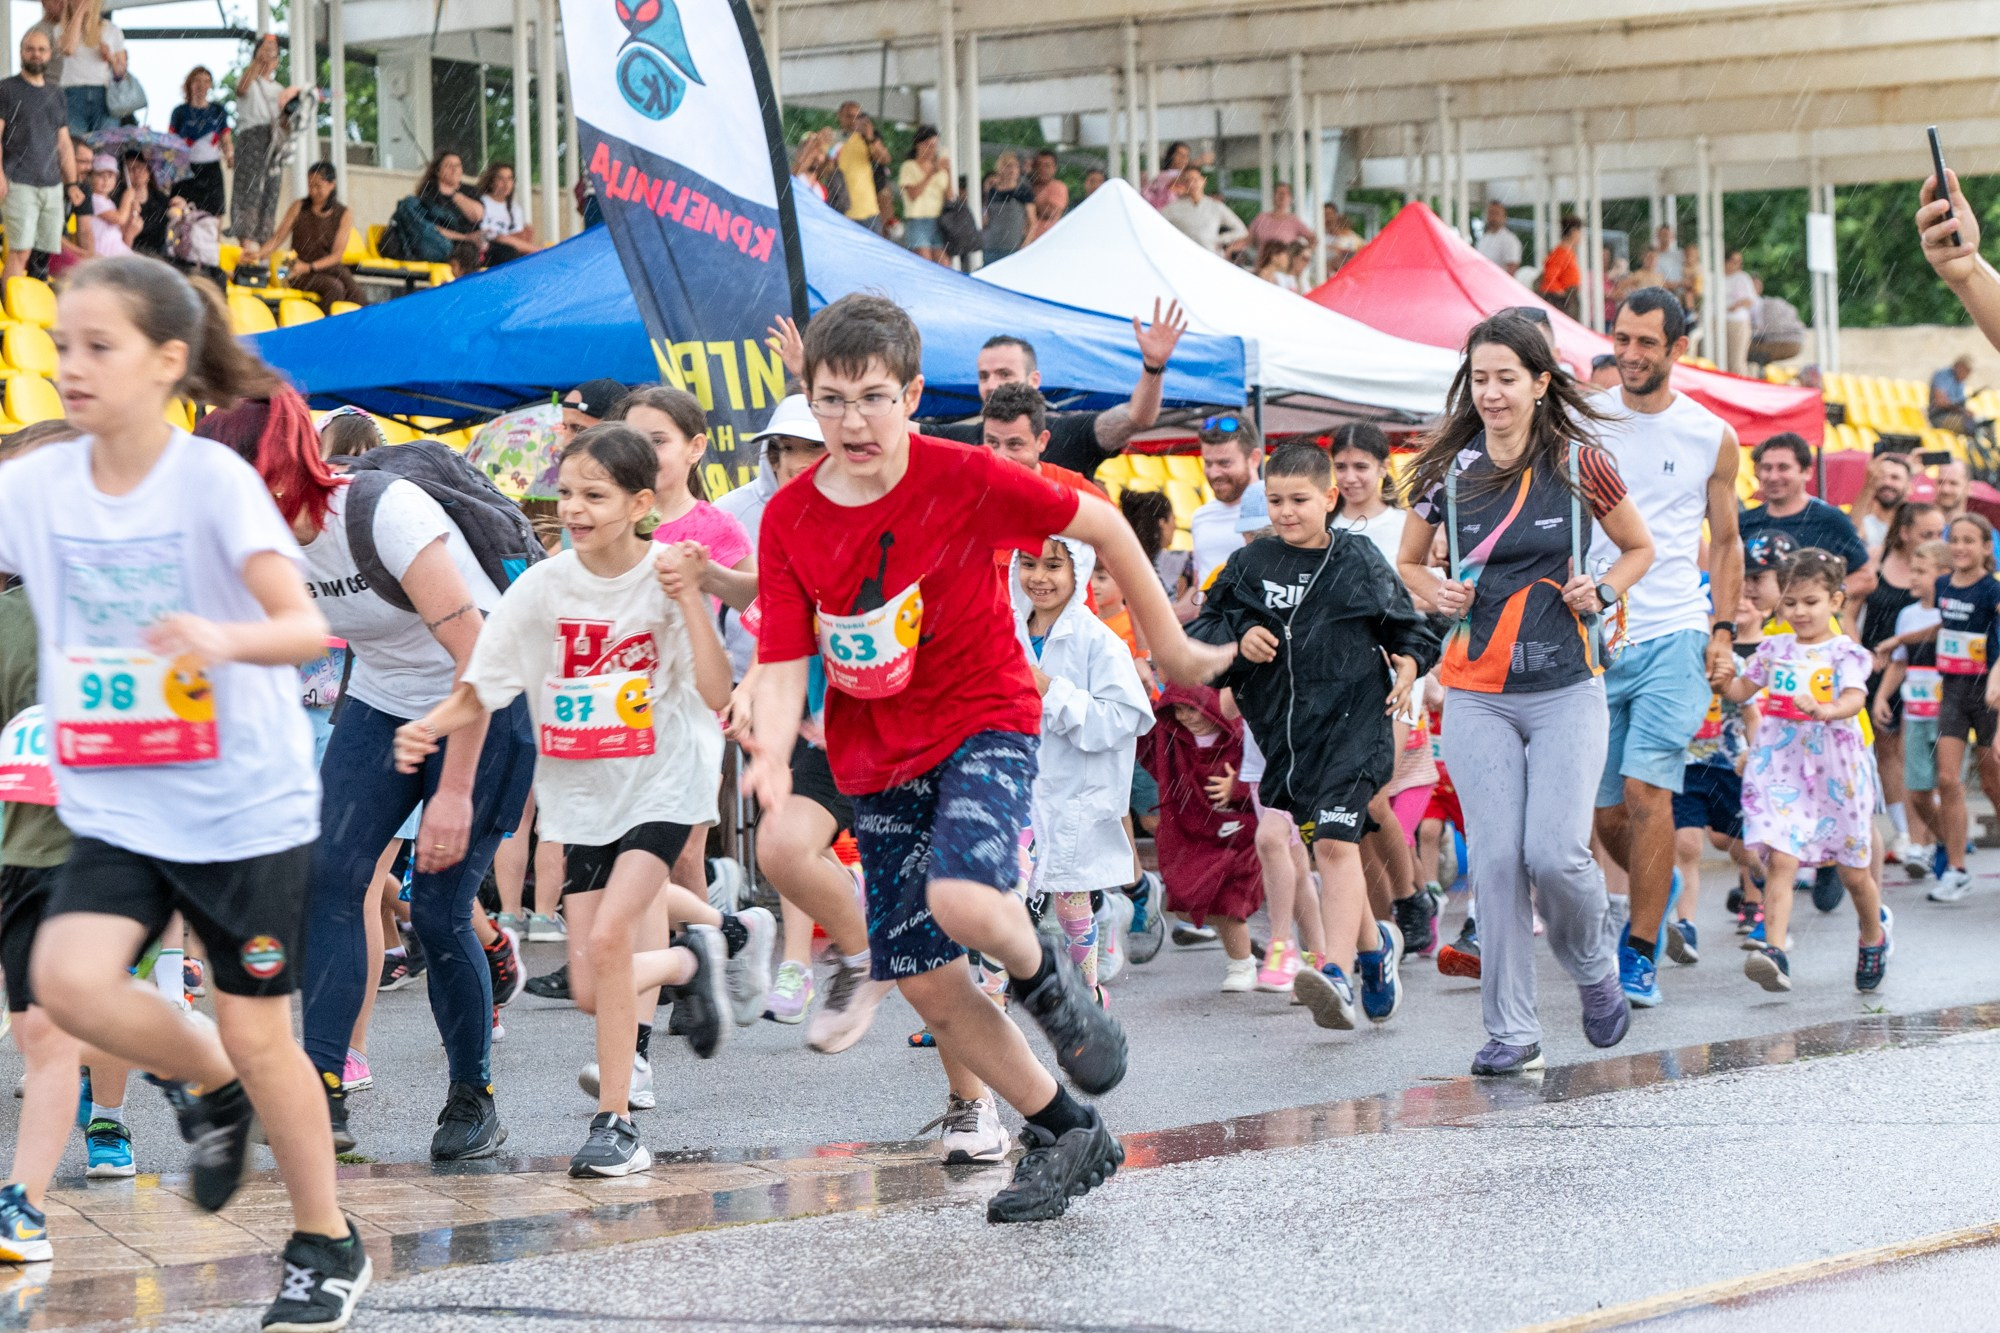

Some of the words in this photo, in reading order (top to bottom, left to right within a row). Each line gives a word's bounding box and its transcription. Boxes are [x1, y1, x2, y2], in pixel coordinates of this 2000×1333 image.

[830, 633, 877, 661] 63
[80, 672, 136, 711] 98
[1774, 671, 1796, 691] 56
[555, 695, 595, 722] 87
[1319, 810, 1358, 827] RIVALS
[890, 956, 917, 974] NEW
[925, 957, 950, 970] YO
